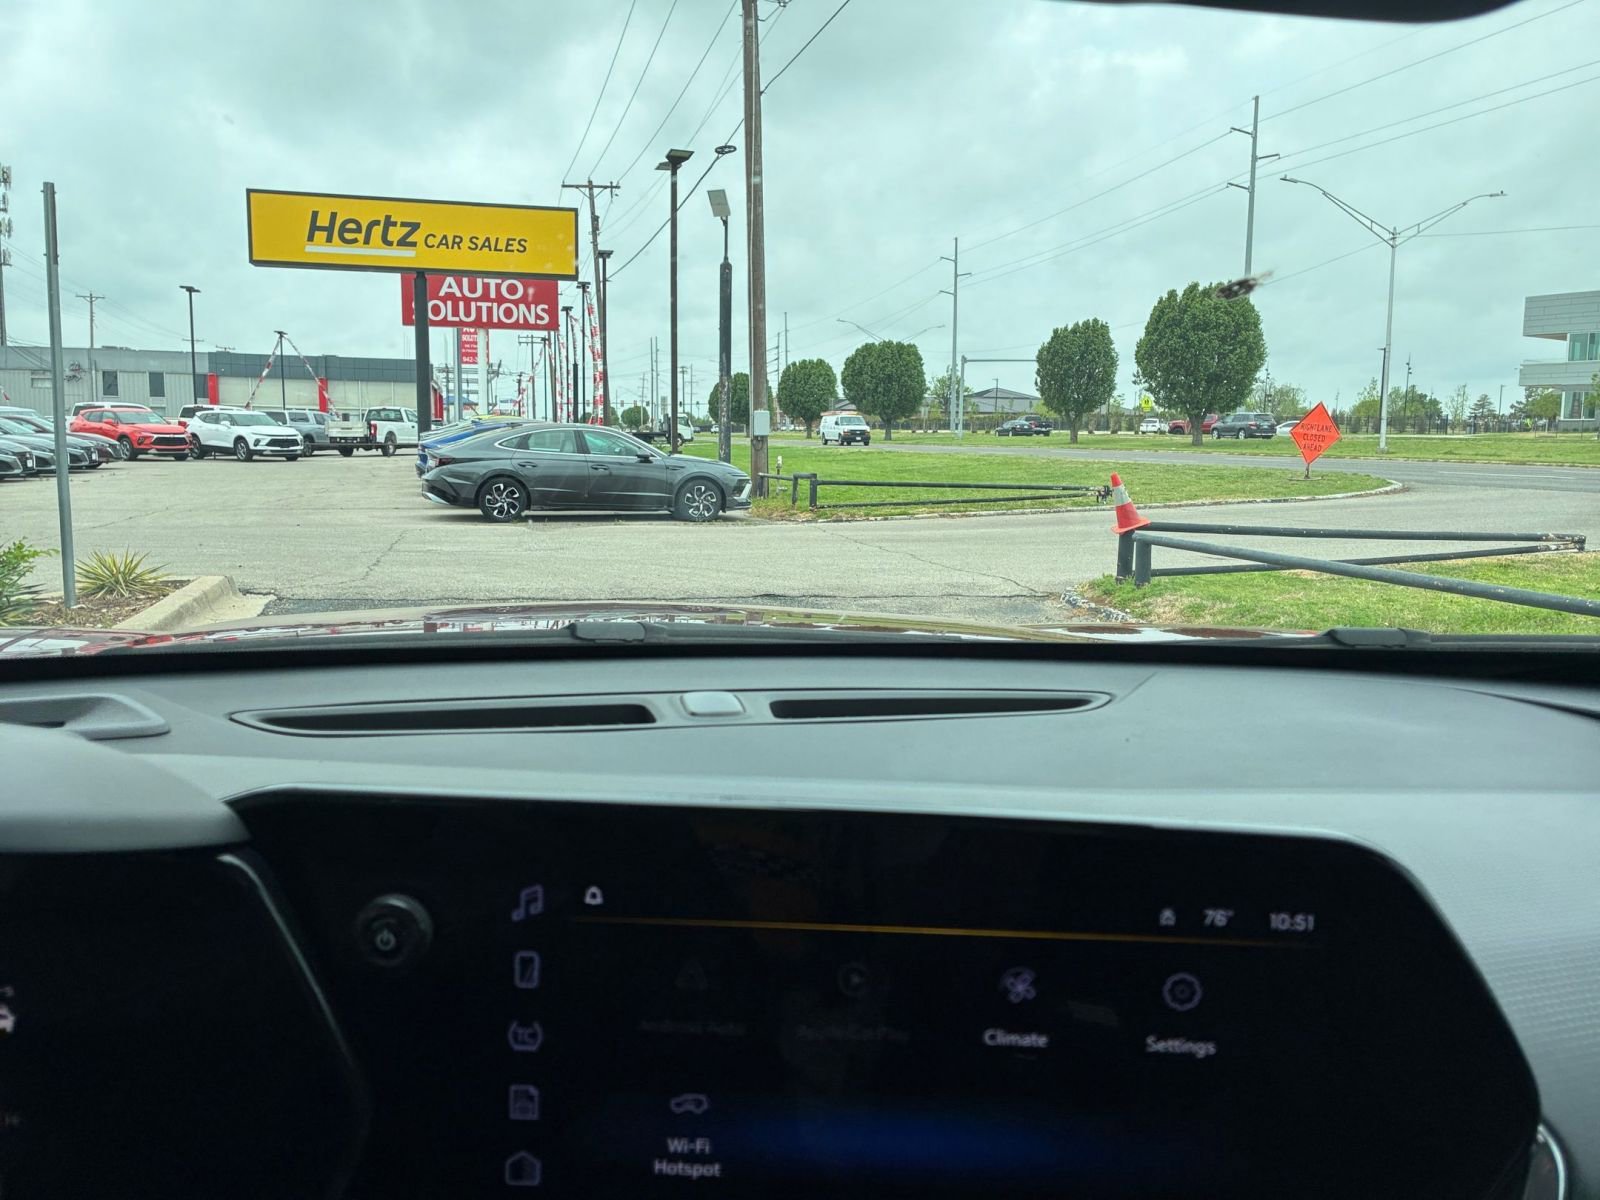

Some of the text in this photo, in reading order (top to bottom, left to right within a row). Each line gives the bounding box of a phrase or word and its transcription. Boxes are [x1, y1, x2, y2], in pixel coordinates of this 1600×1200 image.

[307, 210, 528, 253] Hertz CAR SALES
[438, 276, 524, 300] AUTO
[412, 299, 550, 325] OLUTIONS
[1301, 423, 1332, 432] RIGHT LANE
[1303, 433, 1325, 442] CLOSED
[1303, 443, 1322, 452] AHEAD
[1269, 912, 1315, 932] 10:51
[983, 1027, 1049, 1049] Climate
[1145, 1035, 1218, 1059] Settings
[666, 1137, 711, 1155] Wi-Fi
[653, 1158, 722, 1180] Hotspot
